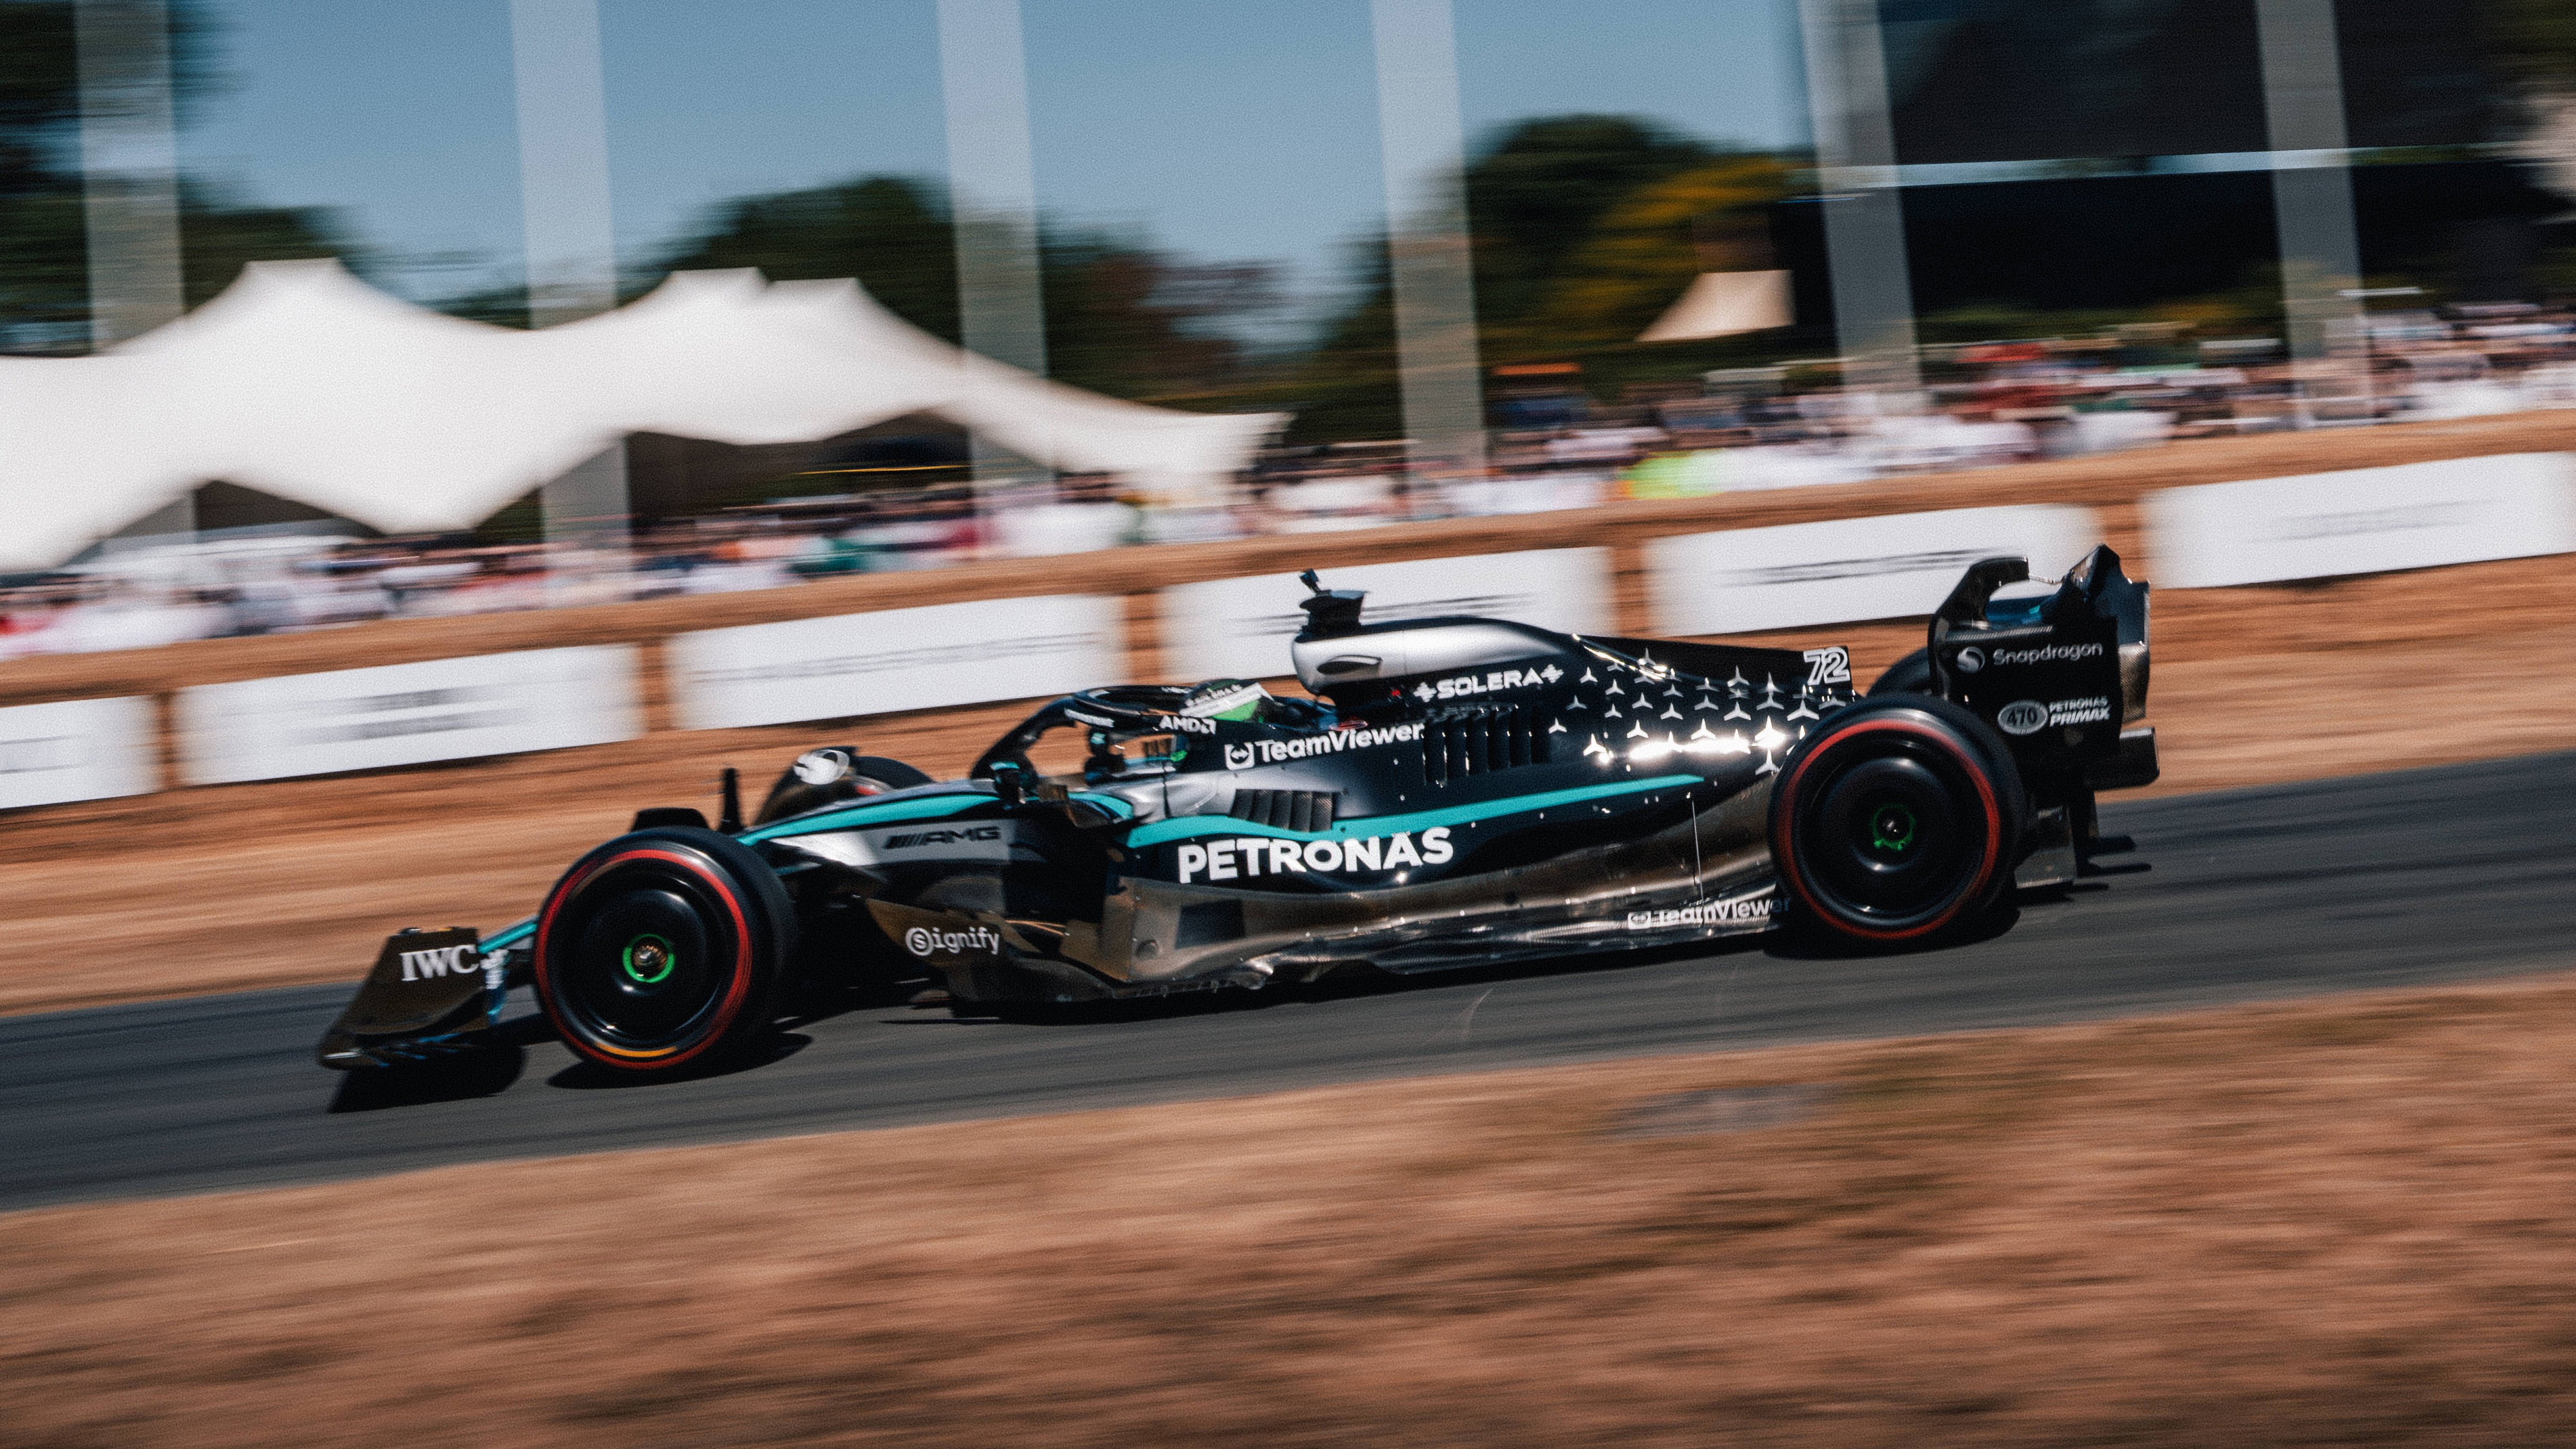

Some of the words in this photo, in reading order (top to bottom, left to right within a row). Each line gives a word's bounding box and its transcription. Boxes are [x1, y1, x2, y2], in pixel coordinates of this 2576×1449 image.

[1803, 646, 1851, 686] 72
[1993, 644, 2103, 666] Snapdragon
[1436, 667, 1544, 699] SOLERA
[1159, 715, 1201, 732] AMD
[2007, 708, 2038, 725] 470
[2049, 707, 2110, 727] PRIMAX
[1255, 722, 1425, 762] TeamViewer
[1178, 826, 1454, 884] PETRONAS
[399, 944, 480, 982] IWC
